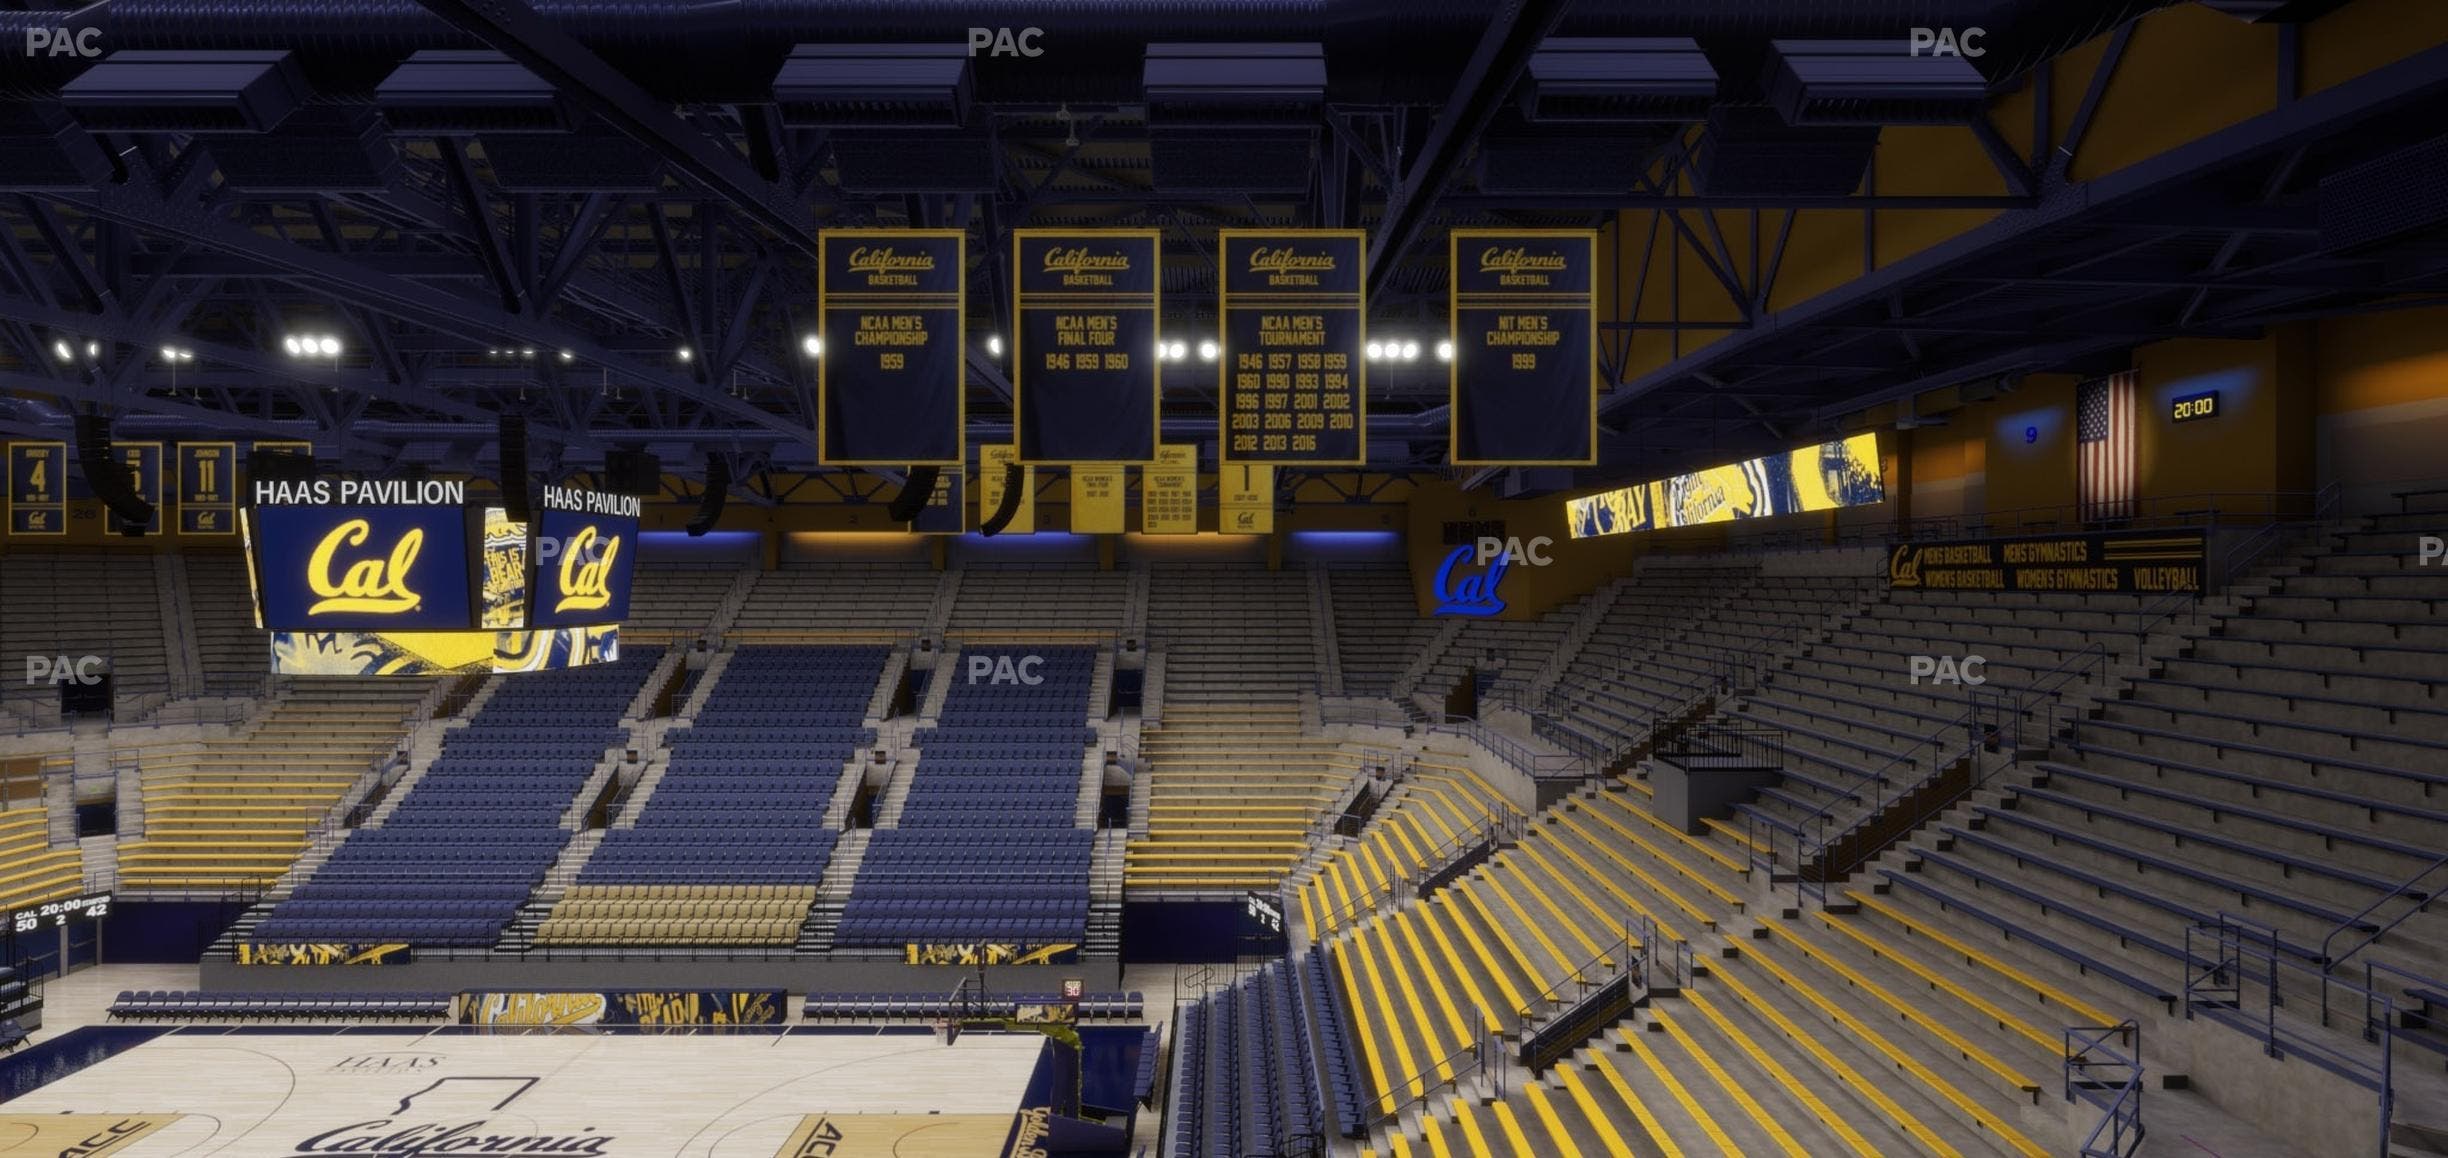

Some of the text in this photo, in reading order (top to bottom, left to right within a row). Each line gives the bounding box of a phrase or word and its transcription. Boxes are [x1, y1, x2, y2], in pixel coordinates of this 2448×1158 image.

[849, 247, 933, 273] California
[1044, 247, 1129, 273] California
[1249, 247, 1335, 273] California
[1480, 247, 1566, 273] California
[867, 273, 917, 286] BASKETBALL
[1062, 273, 1112, 286] BASKETBALL
[1268, 273, 1318, 286] BASKETBALL
[1500, 273, 1548, 286] BASKETBALL
[860, 316, 922, 331] NCAA MEN'S
[1055, 316, 1117, 331] NCAA MEN'S
[1261, 316, 1322, 331] NCAA MEN'S
[1499, 316, 1547, 331] NIT MEN'S
[855, 331, 928, 346] CHAMPIONSHIP
[1057, 331, 1115, 346] FINAL FOUR
[1259, 331, 1325, 346] TOURNAMENT
[1487, 331, 1560, 346] CHAMPIONSHIP
[880, 353, 904, 369] 1959
[1046, 353, 1128, 370] 1946 1959 1960
[1239, 353, 1262, 369] 1946
[1269, 353, 1292, 369] 1957
[1323, 353, 1346, 369] 1959
[1512, 353, 1536, 369] 1999
[1237, 373, 1348, 389] 1960 1990 1993 1994
[1236, 393, 1349, 409] 1996 1997 2001 2002
[2174, 397, 2213, 419] 20:00
[1232, 413, 1259, 429] 2003
[1264, 413, 1292, 429] 2006
[1330, 413, 1353, 429] 2010
[1233, 434, 1316, 451] 2012 2013 2016
[2026, 426, 2038, 444] 9
[30, 460, 46, 492] 4
[199, 460, 215, 492] 11
[255, 480, 465, 504] HAAS PAVILION
[544, 484, 641, 518] HAAS PAVILION
[1945, 545, 1991, 564] BASKETBALL
[2029, 541, 2087, 562] GYMNASTICS
[308, 519, 423, 615] Cal
[556, 526, 620, 614] Cal
[1891, 545, 1923, 587] Cal
[1433, 544, 1509, 616] Cal
[1956, 569, 2005, 588] BASKETBALL
[2056, 568, 2118, 589] GYMNASTICS
[2134, 567, 2199, 590] VOLLEYBALL
[15, 909, 38, 920] CAL
[40, 898, 81, 917] 20:00
[86, 904, 107, 917] 42
[16, 918, 37, 932] 50
[56, 914, 66, 925] 2
[293, 1119, 616, 1158] California
